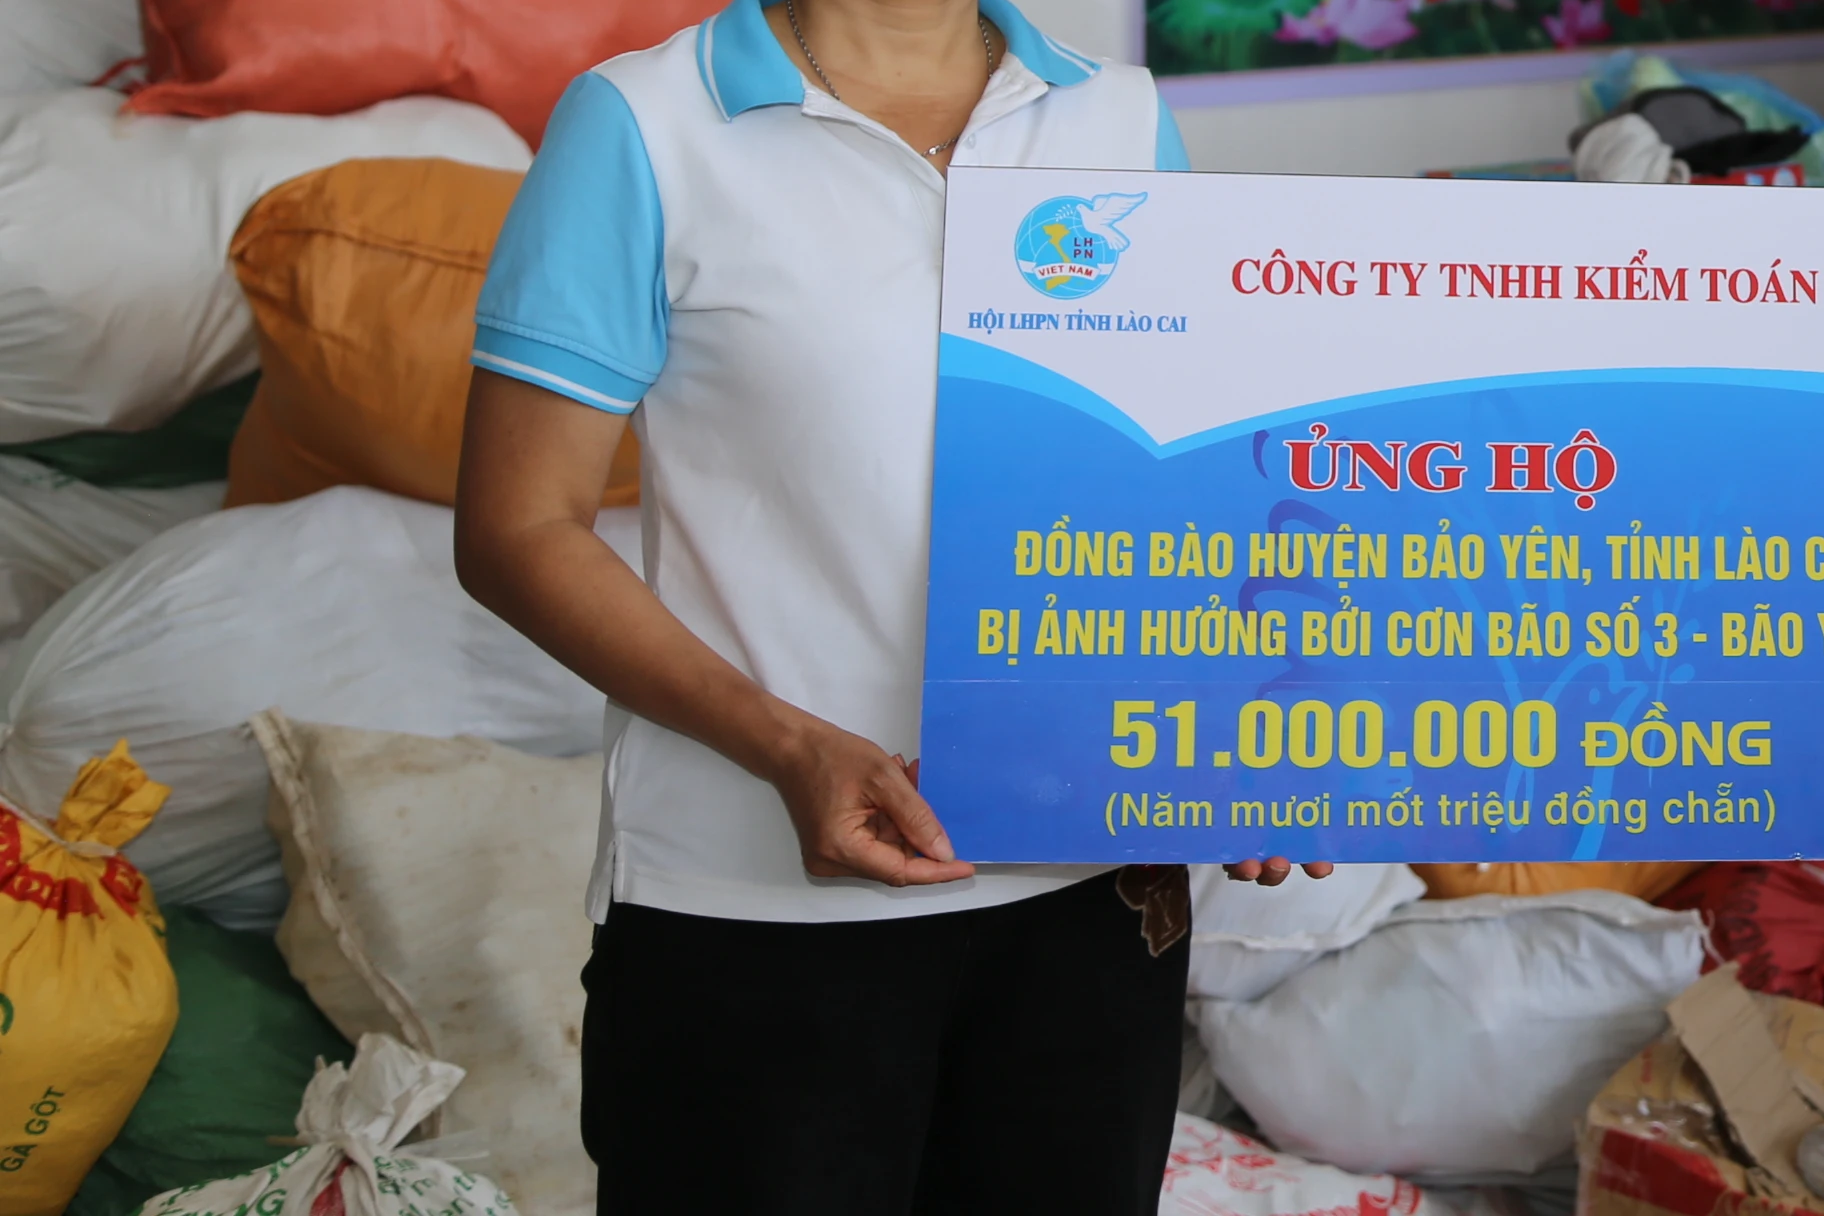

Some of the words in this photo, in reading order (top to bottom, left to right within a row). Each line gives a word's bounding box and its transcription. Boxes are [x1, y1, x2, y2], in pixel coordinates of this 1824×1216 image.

[1038, 265, 1064, 277] VIET
[1068, 265, 1094, 277] NAM
[1232, 248, 1358, 297] CÔNG
[1370, 261, 1428, 297] TY
[1440, 263, 1562, 299] TNHH
[1576, 248, 1688, 302] KIỂM
[1700, 258, 1818, 304] TOÁN
[968, 308, 1005, 335] HỘI
[1010, 313, 1060, 331] LHPN
[1064, 308, 1112, 332] TỈNH
[1116, 310, 1152, 332] LÀO
[1157, 316, 1188, 332] CAI
[1285, 421, 1468, 494] ỦNG
[1487, 427, 1618, 512] HỘ
[1014, 515, 1134, 577] ĐỒNG
[1149, 522, 1234, 578] BÀO
[1249, 523, 1388, 589] HUYỆN
[1402, 519, 1485, 580] BẢO
[1500, 525, 1592, 585] YÊN,
[1606, 520, 1700, 580] TỈNH
[1715, 526, 1791, 581] LÀO
[977, 609, 1021, 666] BỊ
[1034, 593, 1125, 655] ẢNH
[1140, 594, 1287, 657] HƯỞNG
[1302, 595, 1372, 657] BỞI
[1387, 607, 1473, 657] CƠN
[1488, 603, 1571, 657] BÃO
[1586, 596, 1640, 658] SỐ
[1654, 612, 1679, 658] 3
[1693, 633, 1708, 643] -
[1722, 603, 1804, 658] BÃO
[1110, 699, 1557, 769] 51.000.000
[1580, 701, 1772, 768] ĐỒNG
[1105, 793, 1213, 835] (Năm
[1231, 793, 1330, 827] mươi
[1347, 787, 1424, 827] mốt
[1438, 791, 1530, 833] triệu
[1545, 786, 1647, 834] đồng
[1663, 783, 1776, 831] chẵn)
